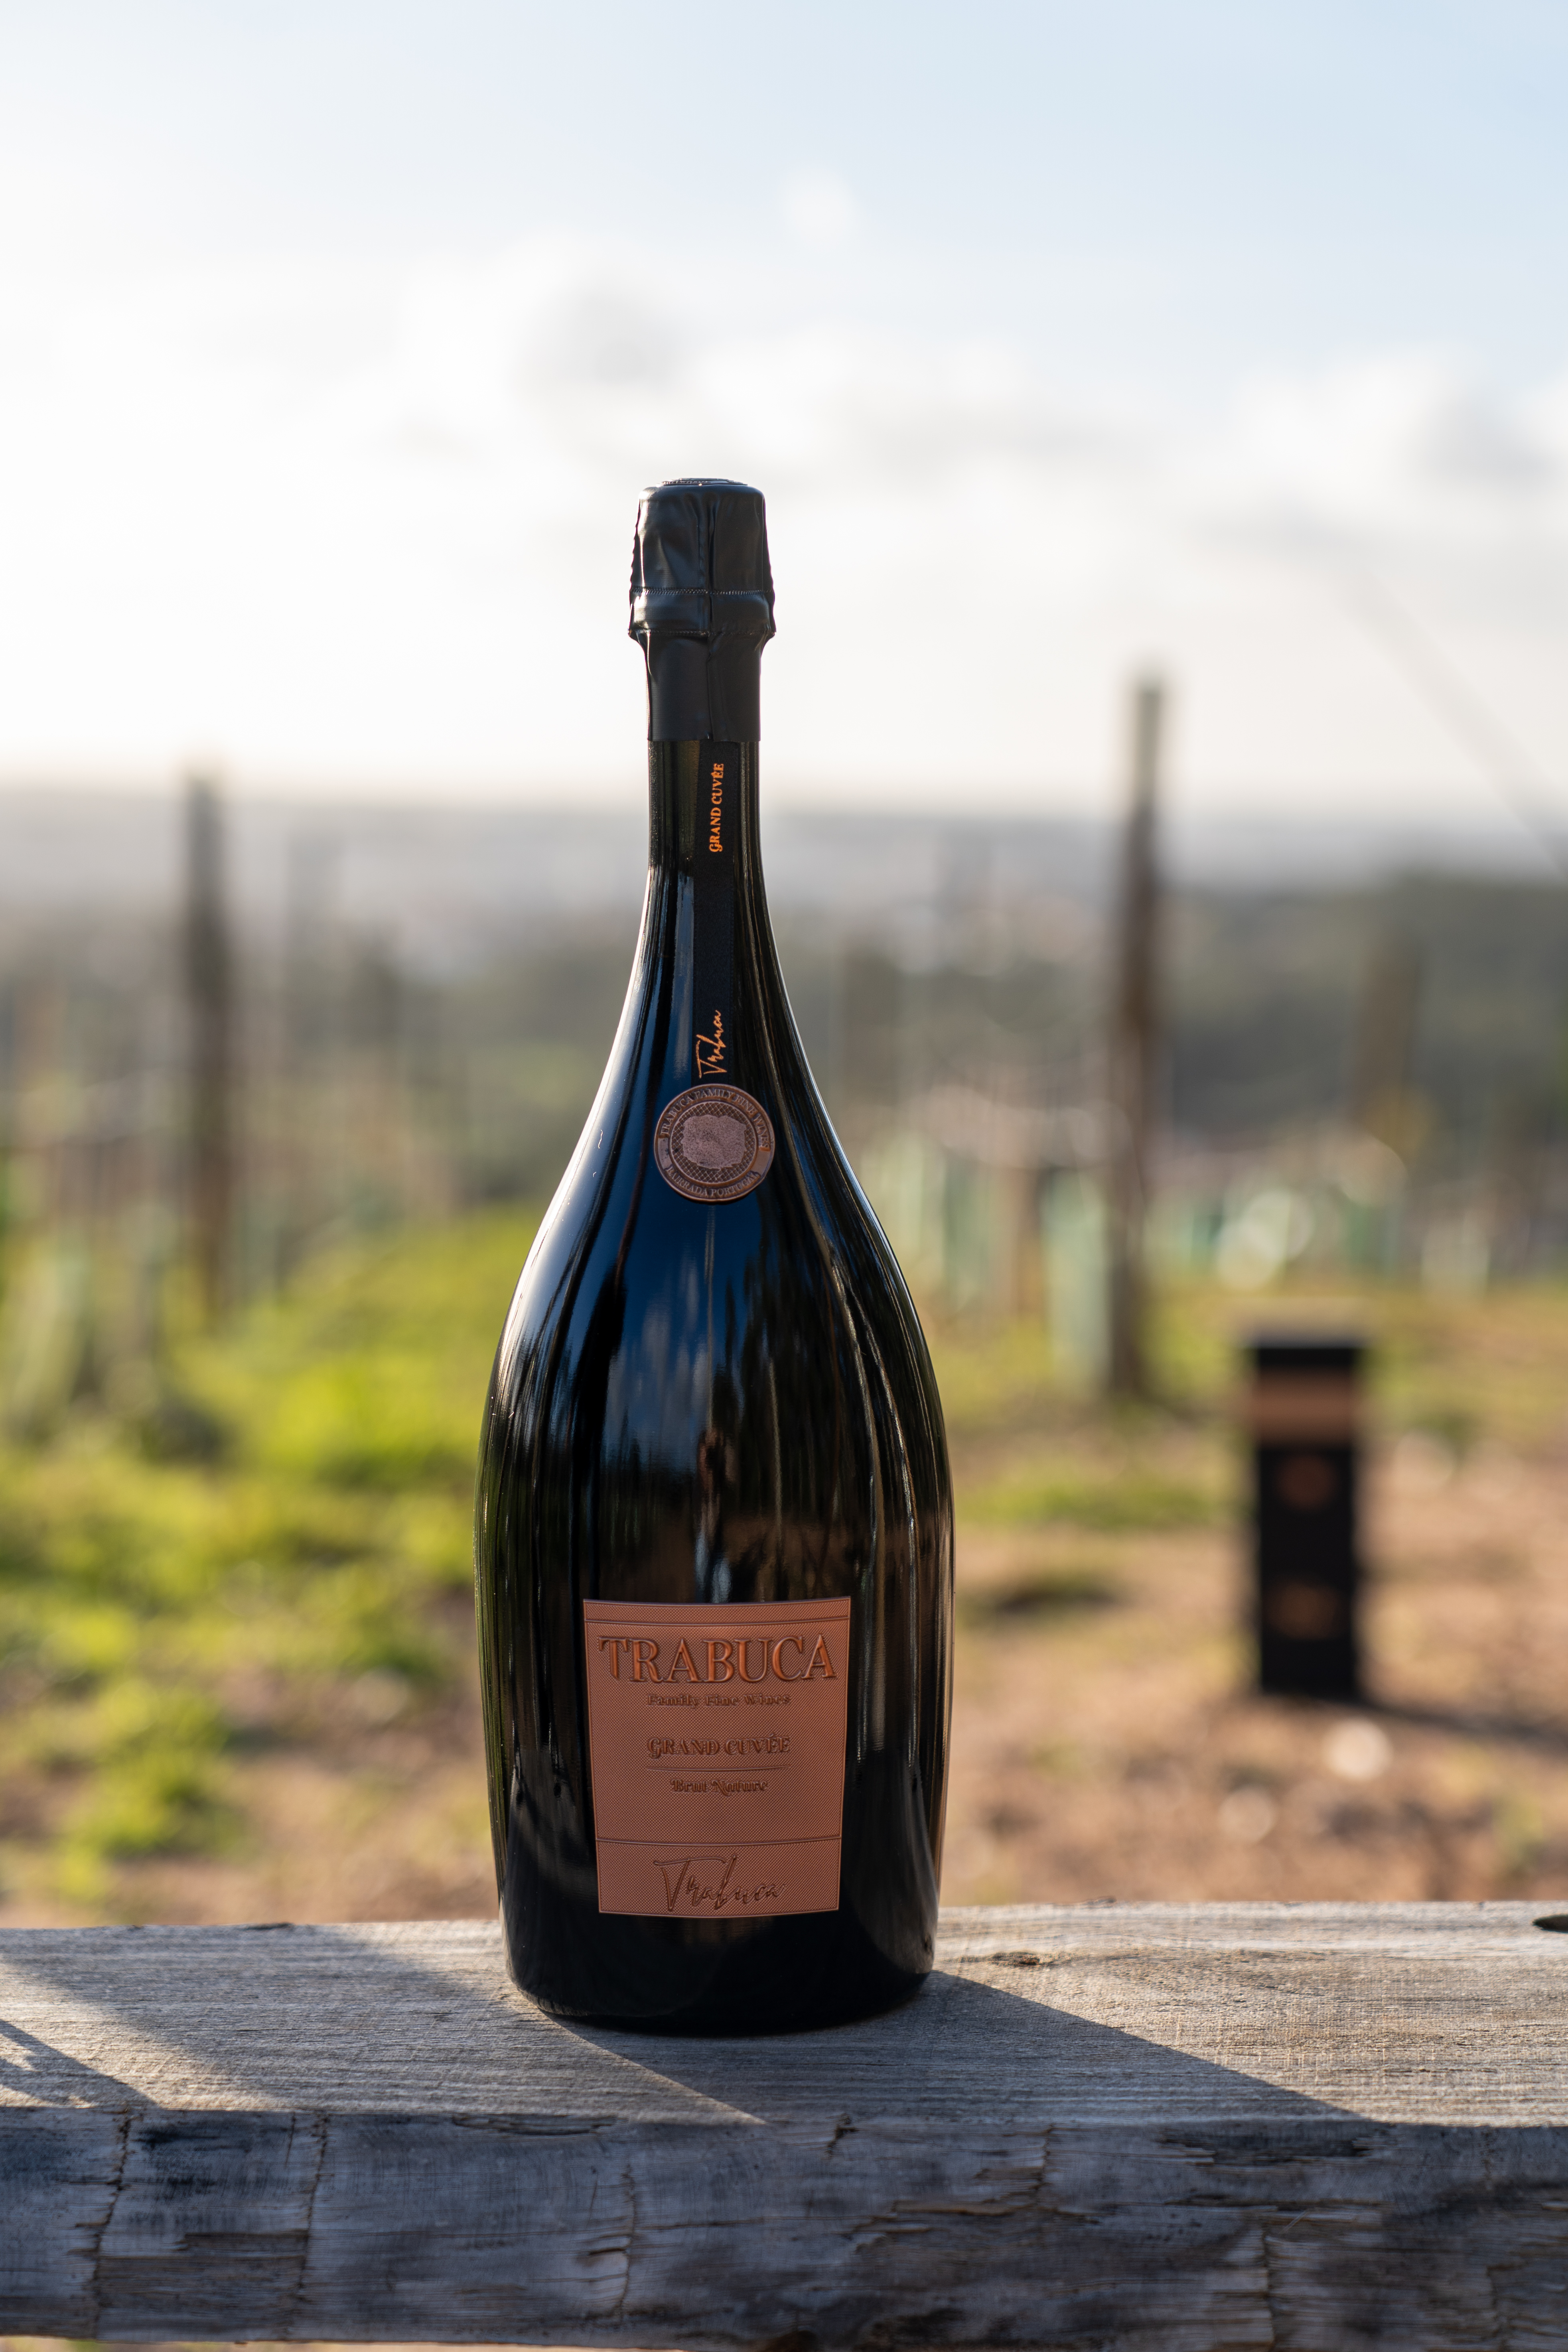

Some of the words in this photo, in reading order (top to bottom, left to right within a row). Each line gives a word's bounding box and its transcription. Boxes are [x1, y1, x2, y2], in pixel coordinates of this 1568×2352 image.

[711, 763, 724, 804] CUVÉE
[709, 807, 723, 852] GRAND
[661, 1094, 693, 1135] TRABUCA
[694, 1088, 734, 1099] FAMILY
[734, 1094, 757, 1114] FINE
[753, 1113, 769, 1148] WINES
[665, 1165, 708, 1196] BAIRRADA
[711, 1172, 759, 1196] PORTUGAL
[598, 1635, 836, 1683] TRABUCA
[647, 1695, 699, 1709] Family
[705, 1695, 738, 1706] Fine
[743, 1694, 790, 1705] Wines
[647, 1738, 718, 1759] GRAND
[724, 1733, 791, 1755] CUVÉE
[671, 1779, 708, 1792] Brut
[711, 1779, 768, 1796] Nature
